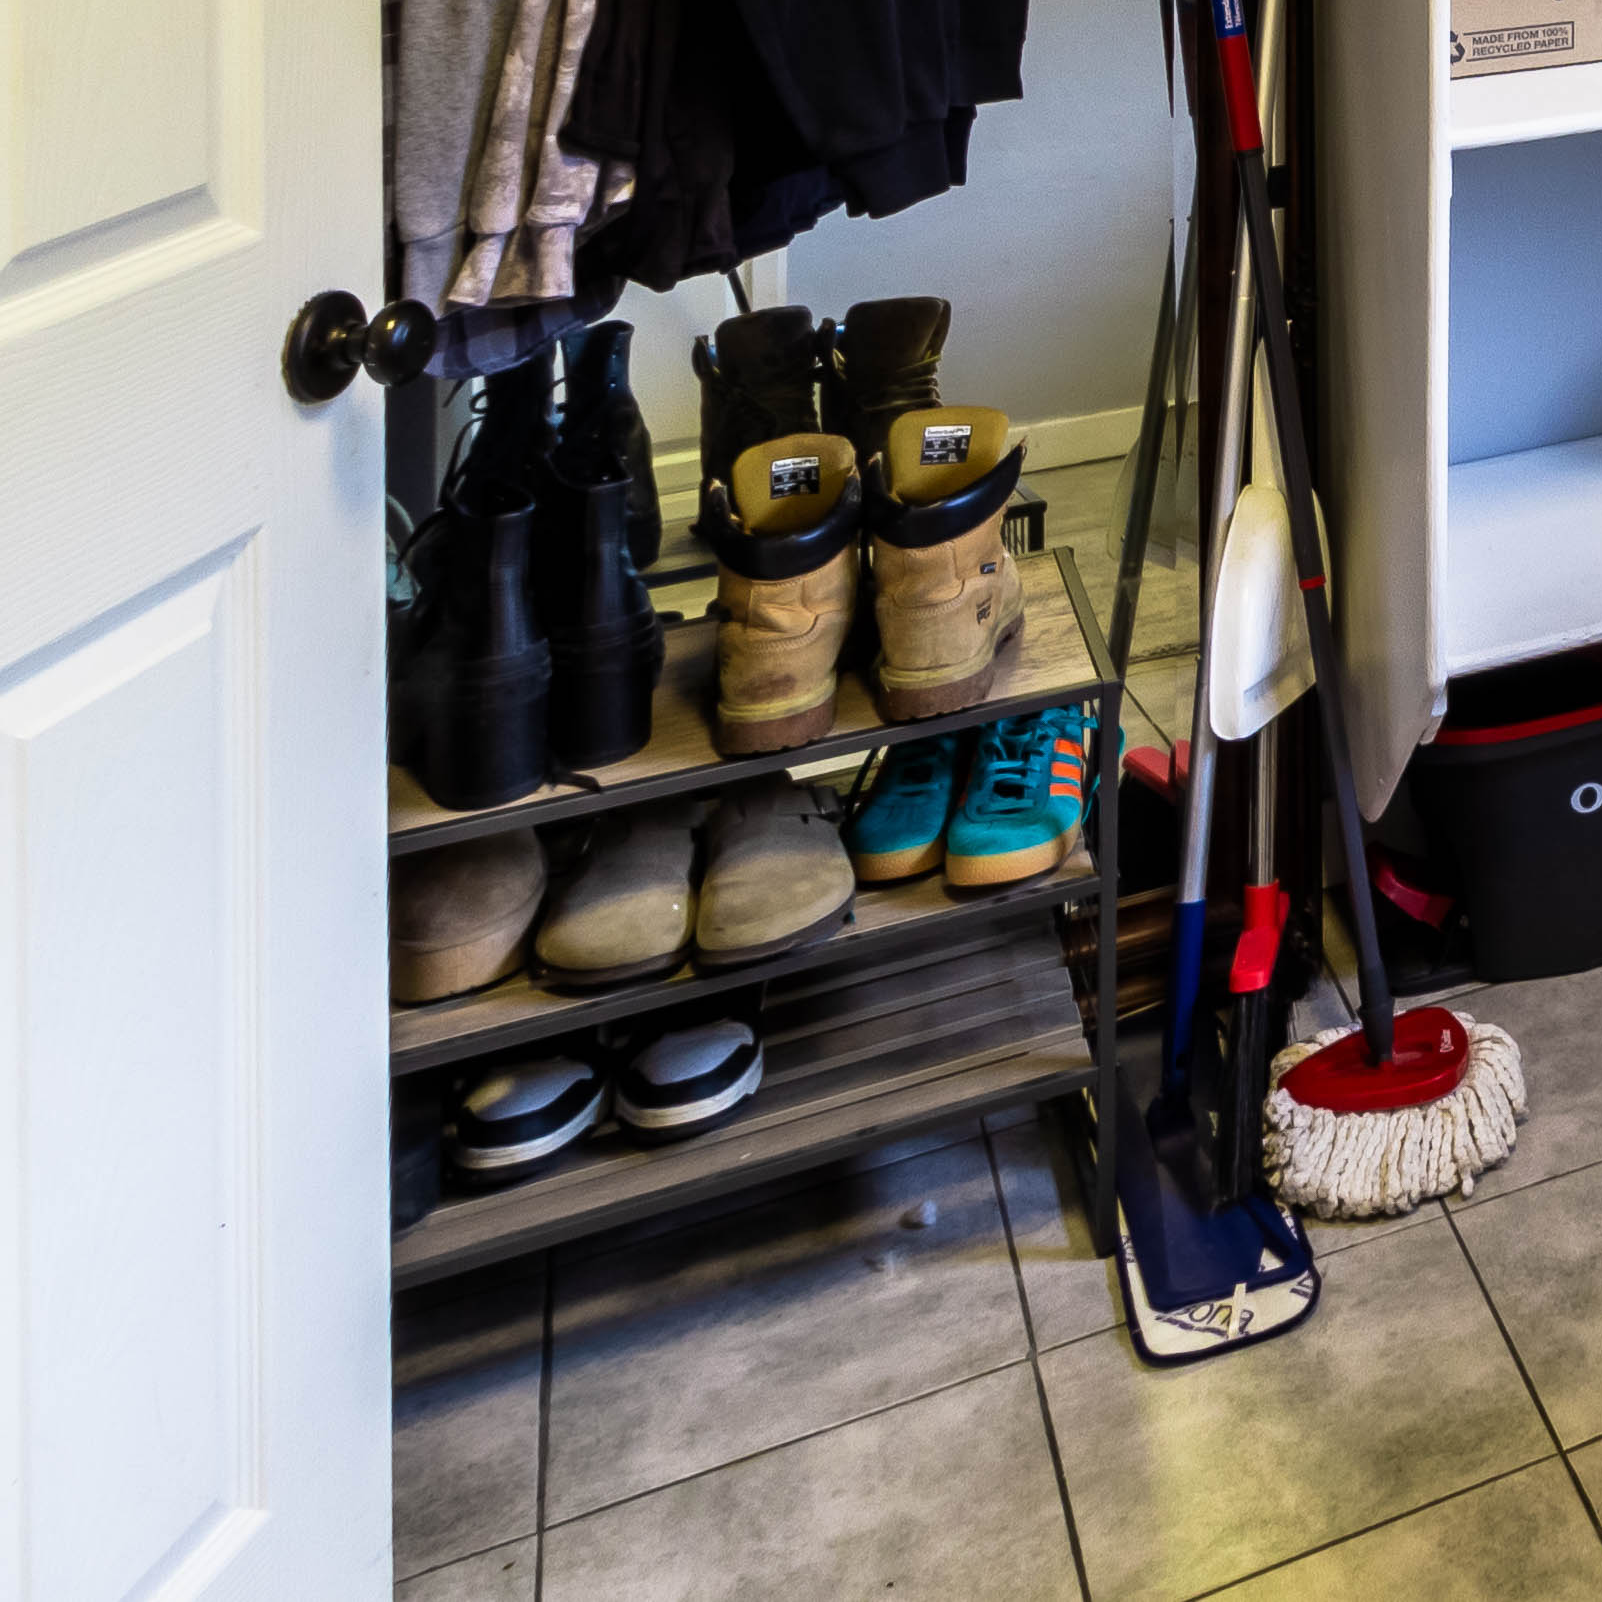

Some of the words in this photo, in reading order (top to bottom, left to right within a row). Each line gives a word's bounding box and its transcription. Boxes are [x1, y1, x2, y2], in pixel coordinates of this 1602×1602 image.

[1472, 33, 1504, 46] MADE
[1507, 29, 1539, 42] FROM
[1542, 25, 1569, 38] 100%
[1472, 41, 1532, 58] RECYCLED
[1534, 36, 1569, 50] PAPER
